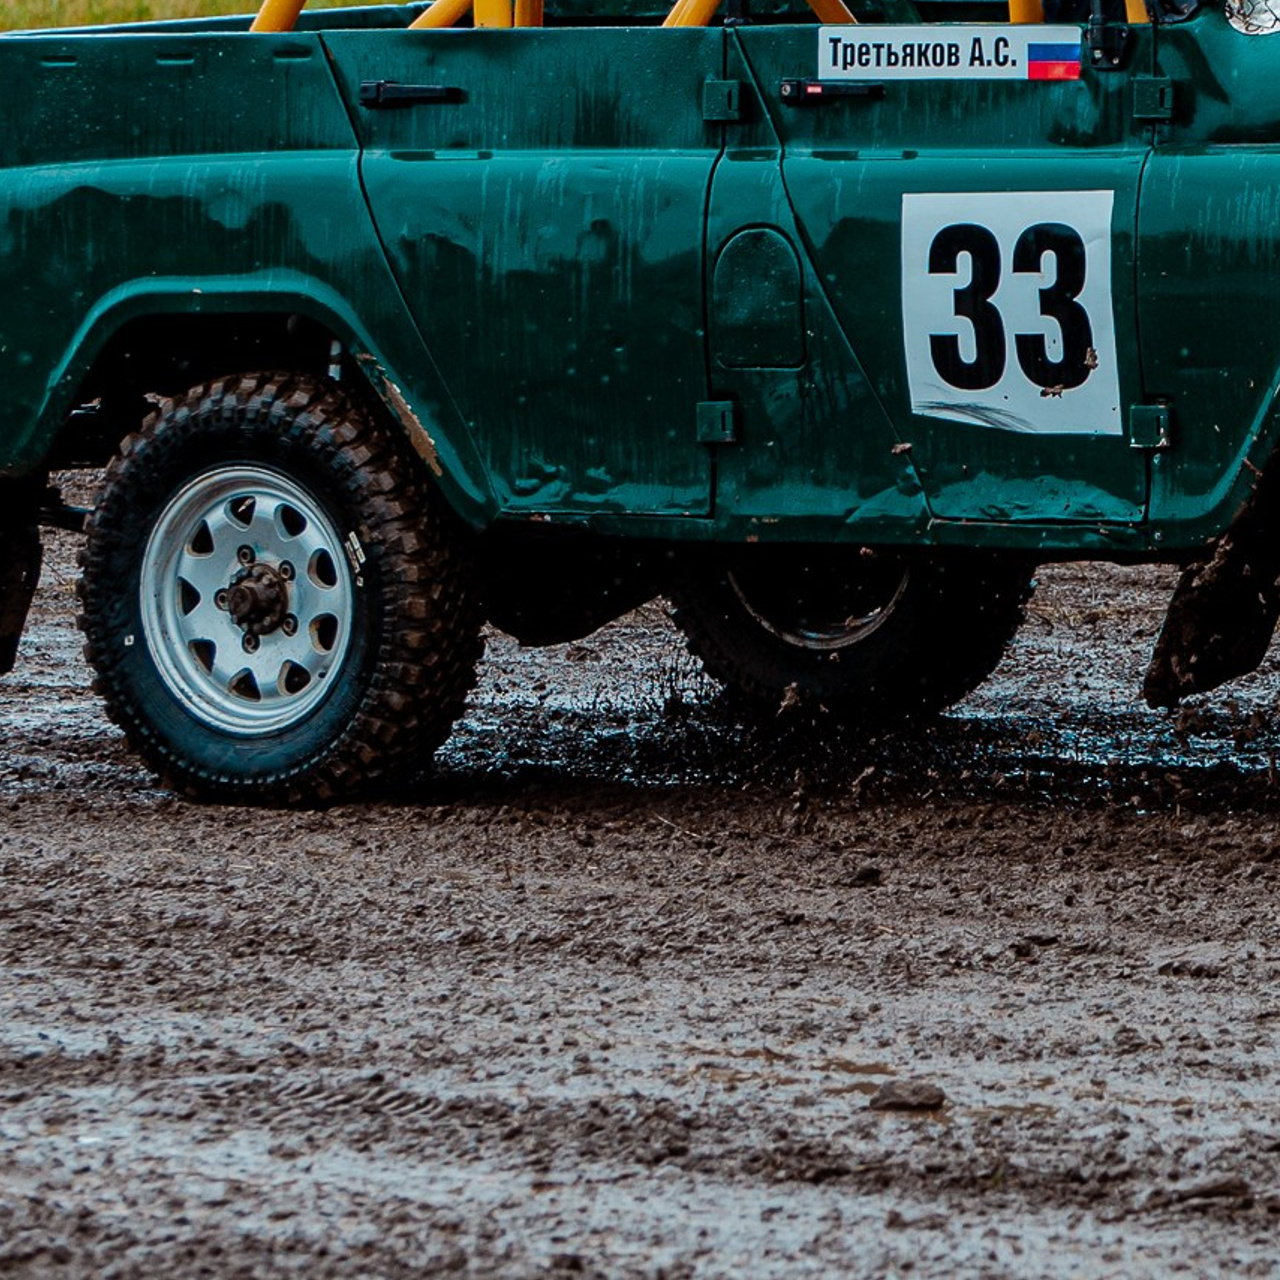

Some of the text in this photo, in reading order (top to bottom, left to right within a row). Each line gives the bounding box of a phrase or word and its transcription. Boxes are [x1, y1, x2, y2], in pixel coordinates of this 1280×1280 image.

[828, 36, 1018, 70] Третьяков А.С.
[927, 222, 1094, 390] 33
